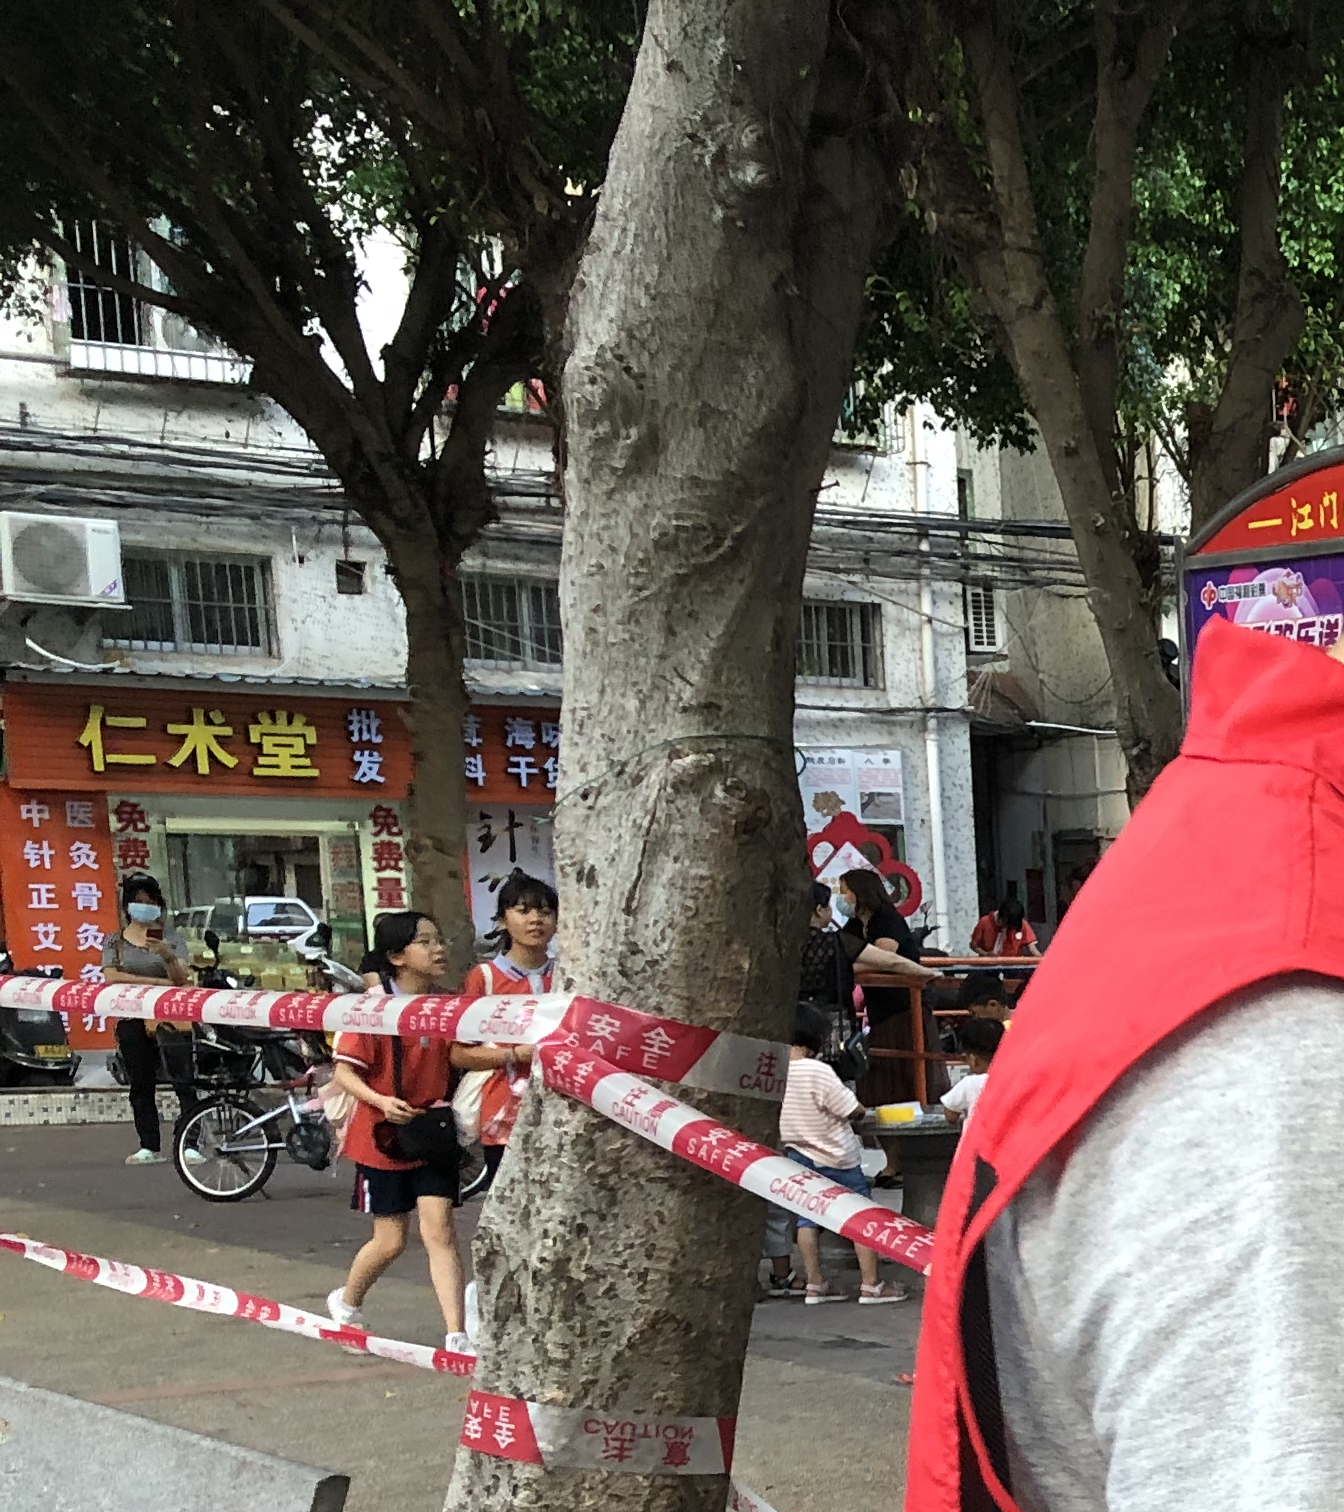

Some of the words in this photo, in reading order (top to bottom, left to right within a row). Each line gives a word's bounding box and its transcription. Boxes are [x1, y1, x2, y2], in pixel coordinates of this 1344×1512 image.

[78, 704, 320, 778] 仁术堂
[347, 708, 386, 784] 批发
[20, 799, 97, 828] 中医
[23, 839, 100, 870] 针灸
[369, 804, 406, 908] 免费量
[27, 881, 103, 912] 正骨
[31, 921, 106, 952] 艾灸
[163, 1002, 194, 1017] SAFE
[278, 1008, 314, 1025] SAFE
[409, 1015, 448, 1033] SAFE
[587, 1012, 677, 1059] 安全
[756, 1051, 779, 1077] 注
[611, 1101, 659, 1138] CAUTION
[686, 1141, 733, 1174] SAFE
[769, 1177, 831, 1217] CAUTION
[862, 1221, 921, 1260] SAFE
